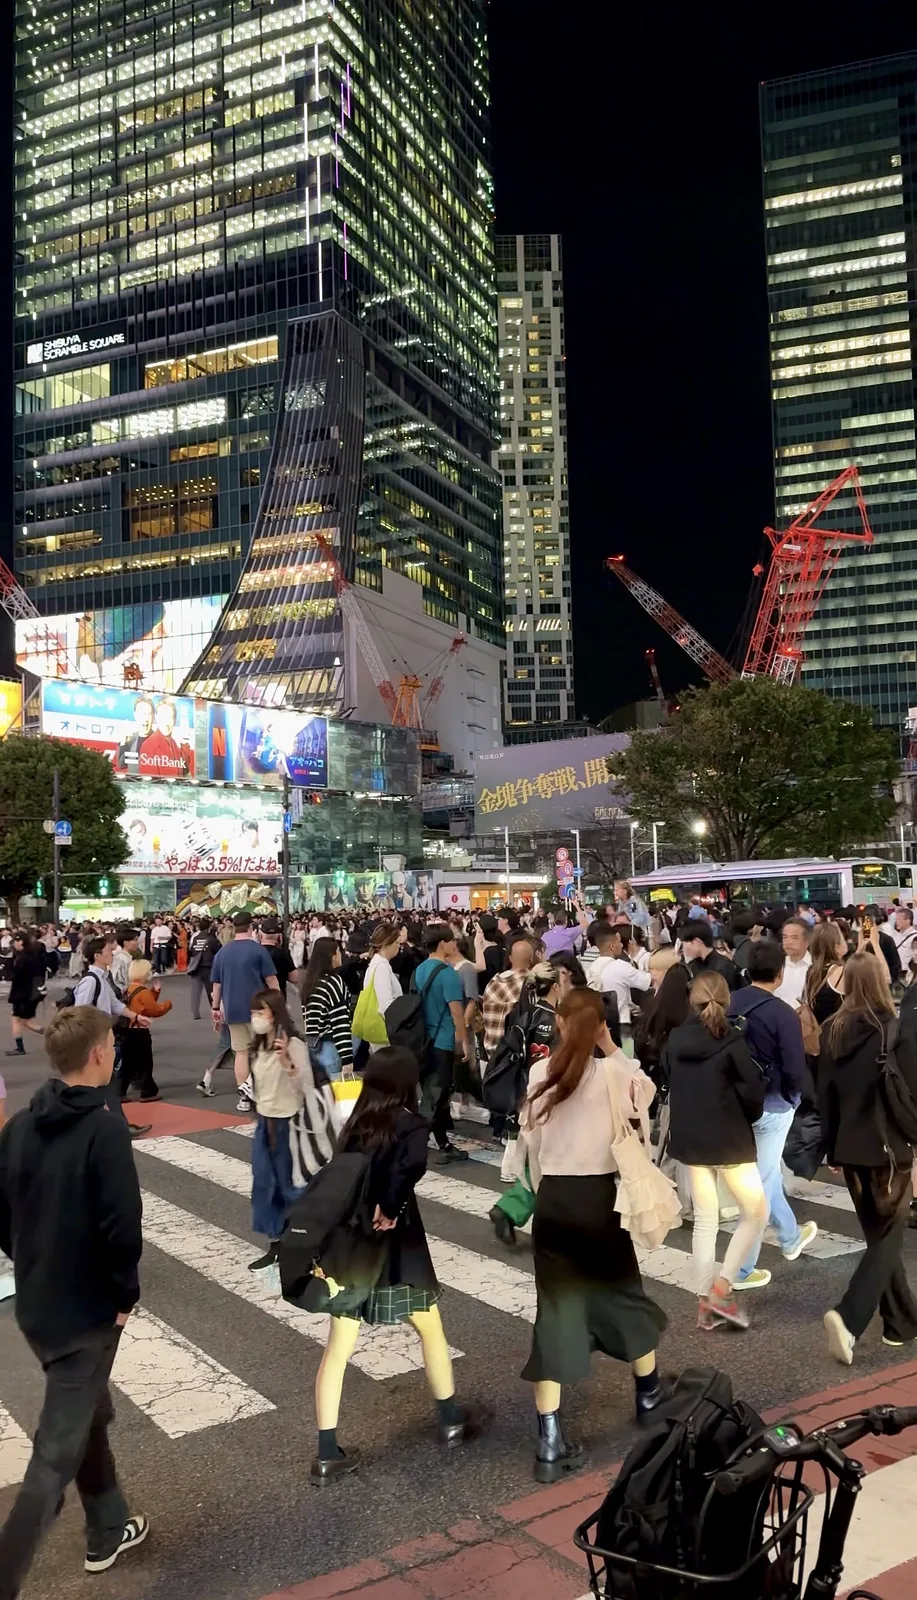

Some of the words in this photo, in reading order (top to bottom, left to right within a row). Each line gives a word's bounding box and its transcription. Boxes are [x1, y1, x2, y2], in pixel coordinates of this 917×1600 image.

[43, 334, 80, 350] SHIBUYA
[43, 342, 89, 361] SCRAMBLE
[89, 333, 125, 349] SQUARE
[60, 720, 115, 736] オトロク
[140, 753, 187, 769] SoftBank
[476, 757, 618, 815] 金塊争奪戦、開
